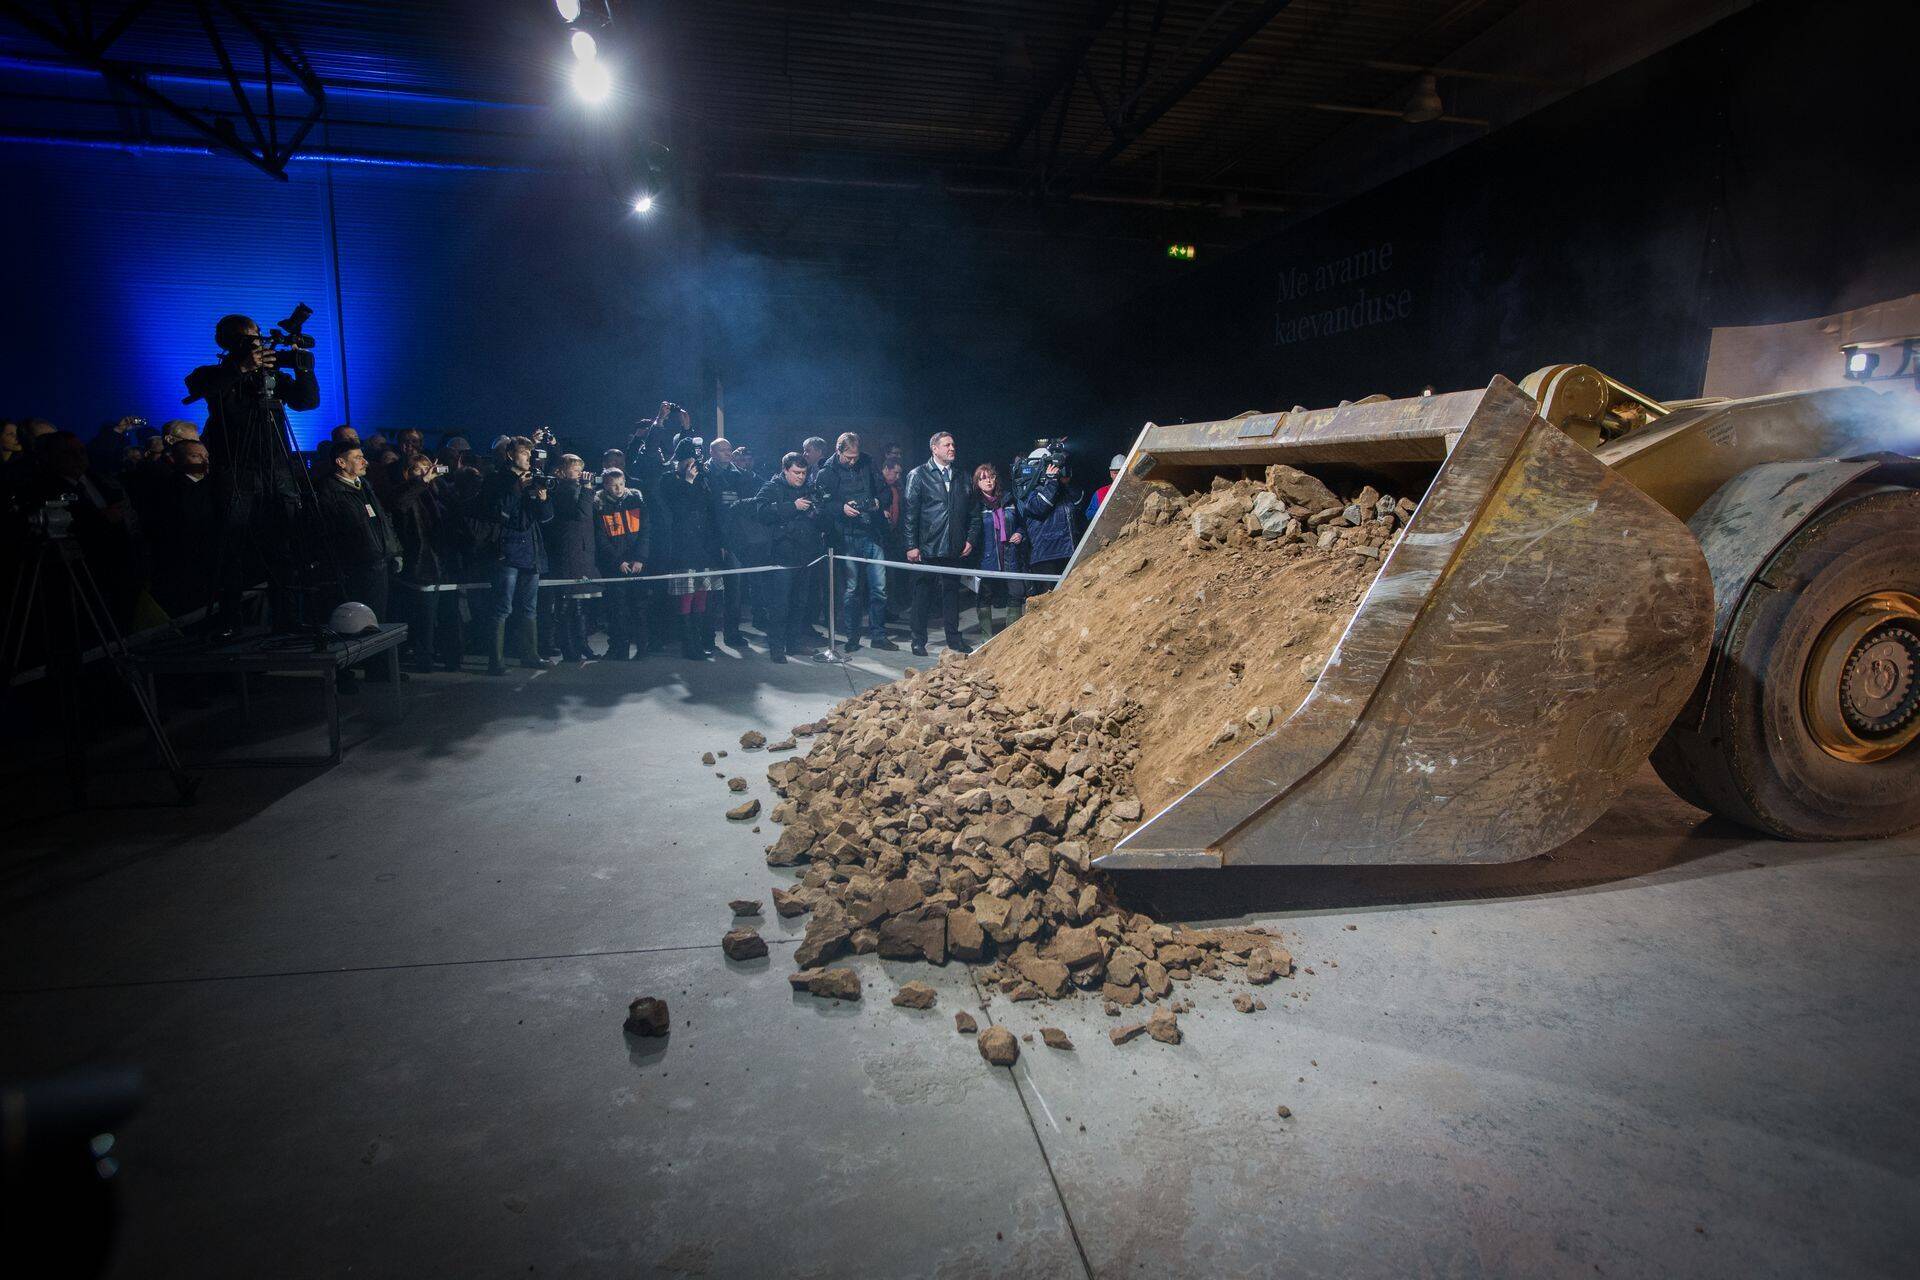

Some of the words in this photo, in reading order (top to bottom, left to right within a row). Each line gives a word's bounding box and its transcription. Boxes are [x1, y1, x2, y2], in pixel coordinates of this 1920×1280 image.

[1276, 266, 1308, 304] Me
[1314, 242, 1393, 292] avame
[1273, 288, 1412, 346] kaevanduse
